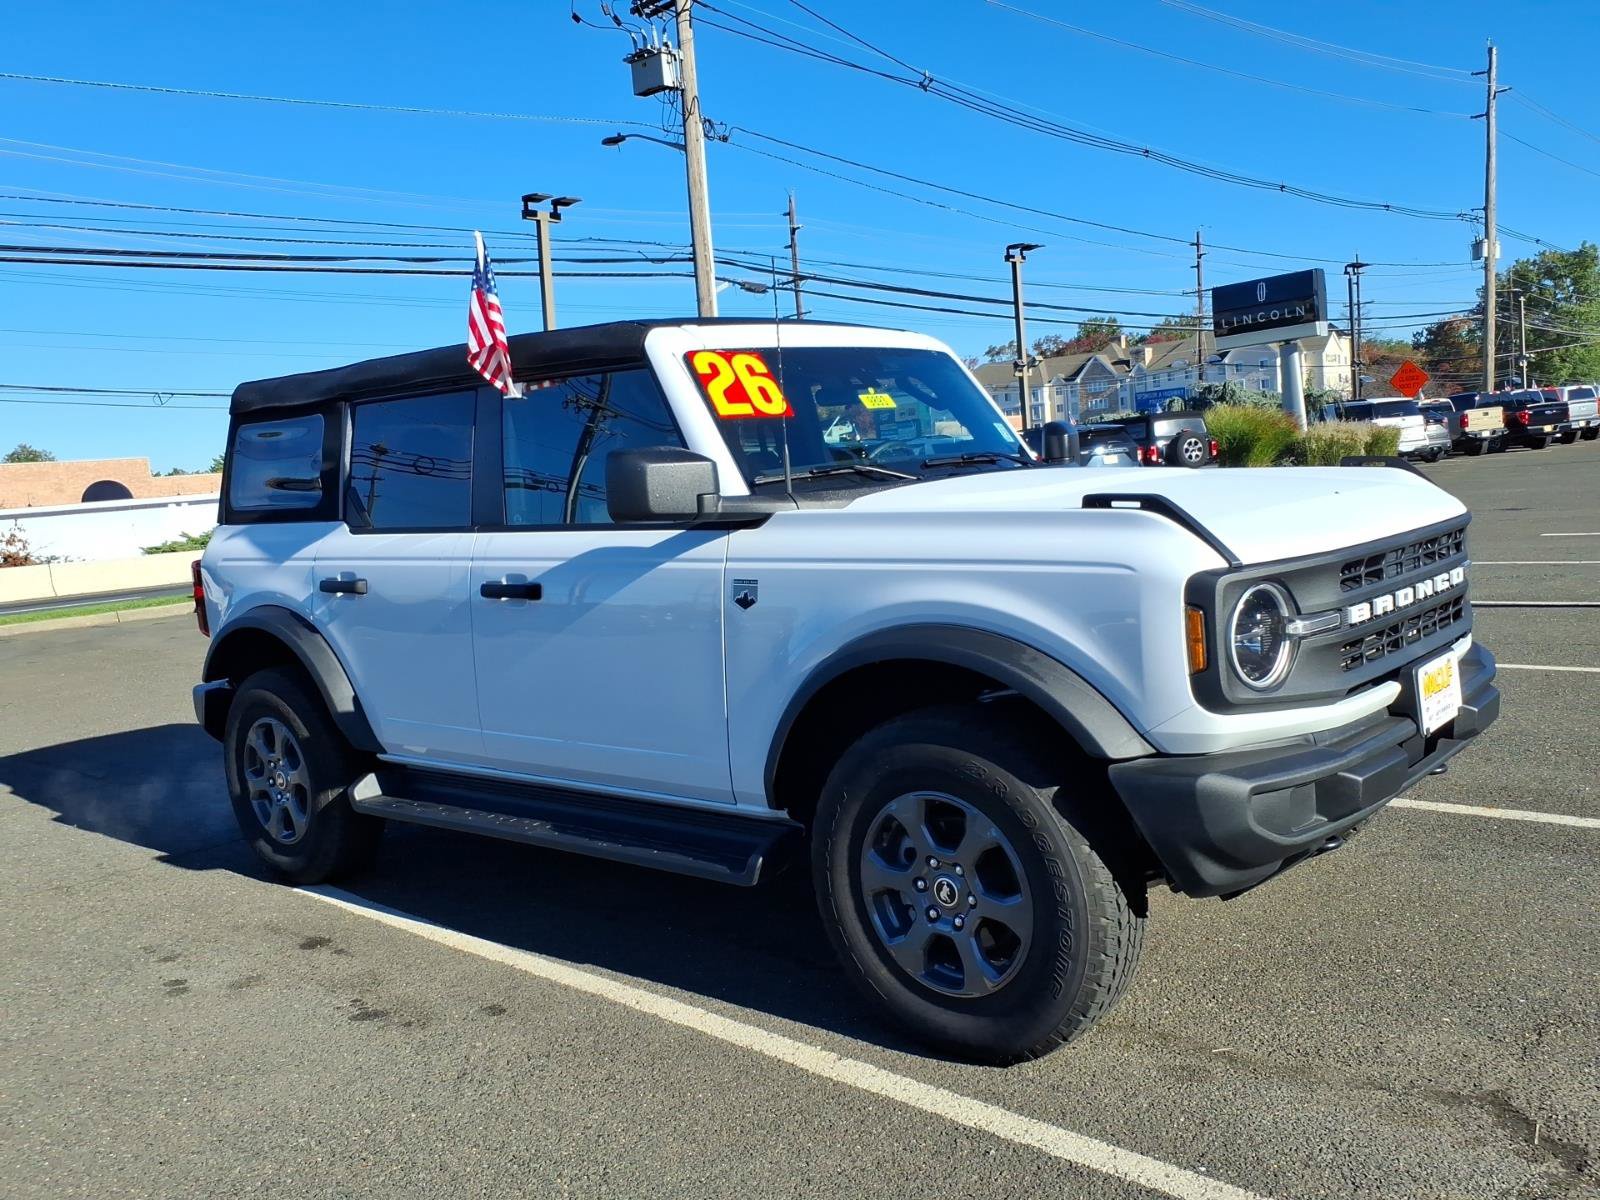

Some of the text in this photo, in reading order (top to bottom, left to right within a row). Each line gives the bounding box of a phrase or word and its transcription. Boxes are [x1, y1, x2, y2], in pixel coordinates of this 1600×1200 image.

[1222, 305, 1305, 328] LINCOLN
[693, 351, 787, 415] 26
[1347, 566, 1465, 624] BRONCO
